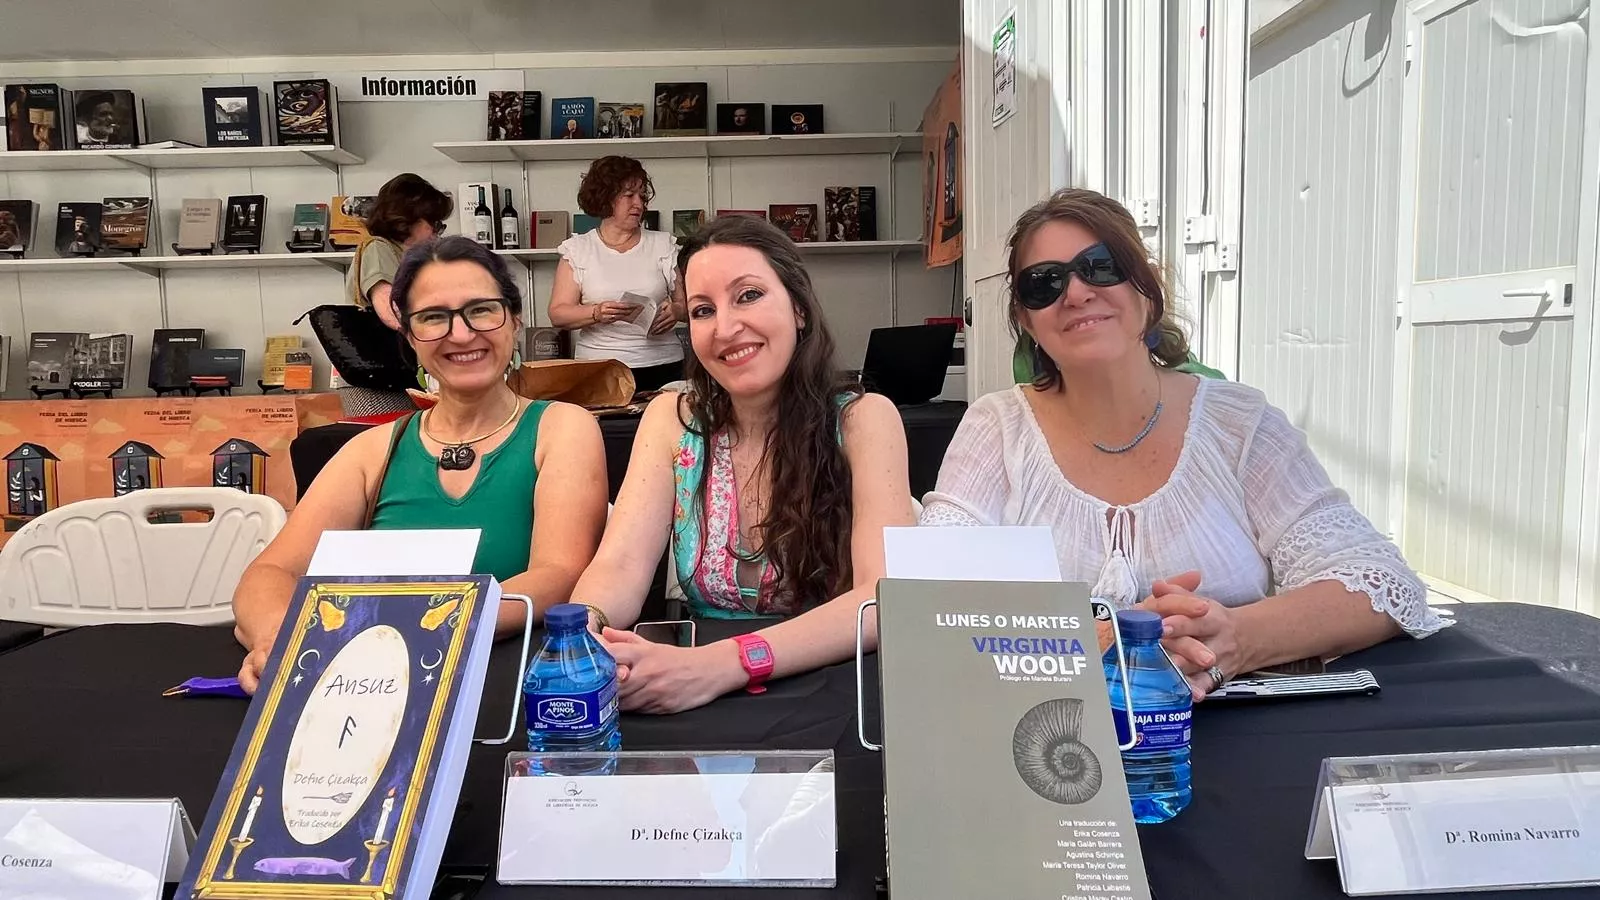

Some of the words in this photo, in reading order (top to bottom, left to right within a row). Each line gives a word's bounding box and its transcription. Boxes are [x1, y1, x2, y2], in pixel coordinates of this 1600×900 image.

[361, 76, 476, 96] Información
[103, 224, 142, 233] Monegros
[936, 613, 990, 628] LUNES
[994, 615, 1007, 628] O
[1011, 615, 1080, 629] MARTES
[972, 637, 1085, 655] VIRGINIA
[992, 655, 1087, 675] WOOLF
[324, 674, 399, 698] Ansuz
[1133, 714, 1153, 726] BAJA
[1154, 714, 1167, 723] EN
[1168, 710, 1192, 722] SODIO
[293, 773, 326, 785] Defne
[289, 819, 310, 828] Erika
[1058, 819, 1073, 827] Una
[653, 828, 689, 841] Defne
[692, 828, 743, 843] Çizakça
[1073, 829, 1091, 838] Erika
[1090, 829, 1121, 838] Cosenza
[1468, 828, 1521, 843] Romina
[1524, 827, 1580, 840] Navarro
[1, 854, 53, 868] Cosenza
[1062, 861, 1085, 870] Teresa
[1075, 872, 1101, 881] Romina
[1101, 873, 1129, 881] Navarro
[1076, 883, 1102, 892] Patricia
